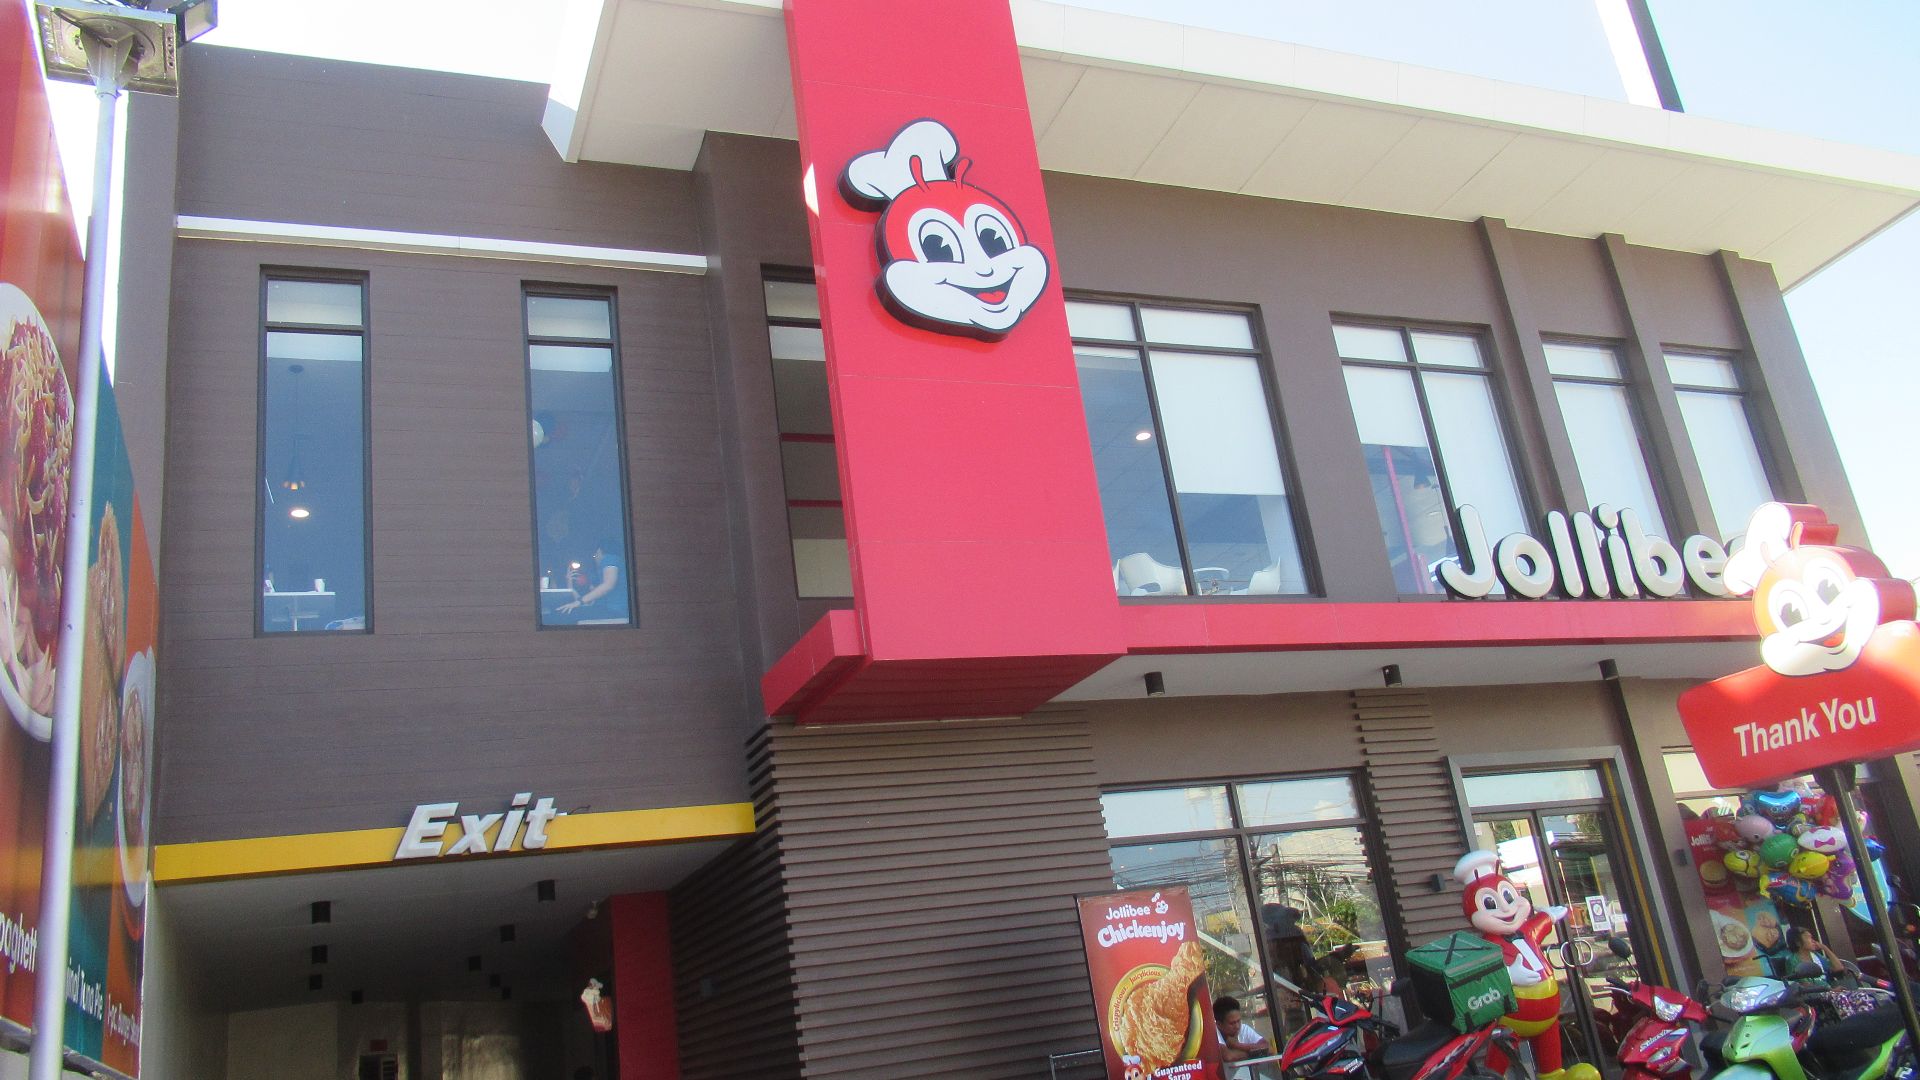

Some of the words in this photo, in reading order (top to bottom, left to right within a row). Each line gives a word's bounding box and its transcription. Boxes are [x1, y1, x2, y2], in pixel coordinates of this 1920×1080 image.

[1440, 502, 1745, 598] Jollibe
[1733, 707, 1820, 757] Thank
[1818, 696, 1877, 734] You
[394, 792, 558, 860] Exit
[1097, 919, 1185, 948] Chickenjoy
[1105, 904, 1151, 920] Jollibee
[0, 911, 38, 974] aghett
[1467, 986, 1501, 1010] Grab
[1154, 1060, 1203, 1078] Guaranteed
